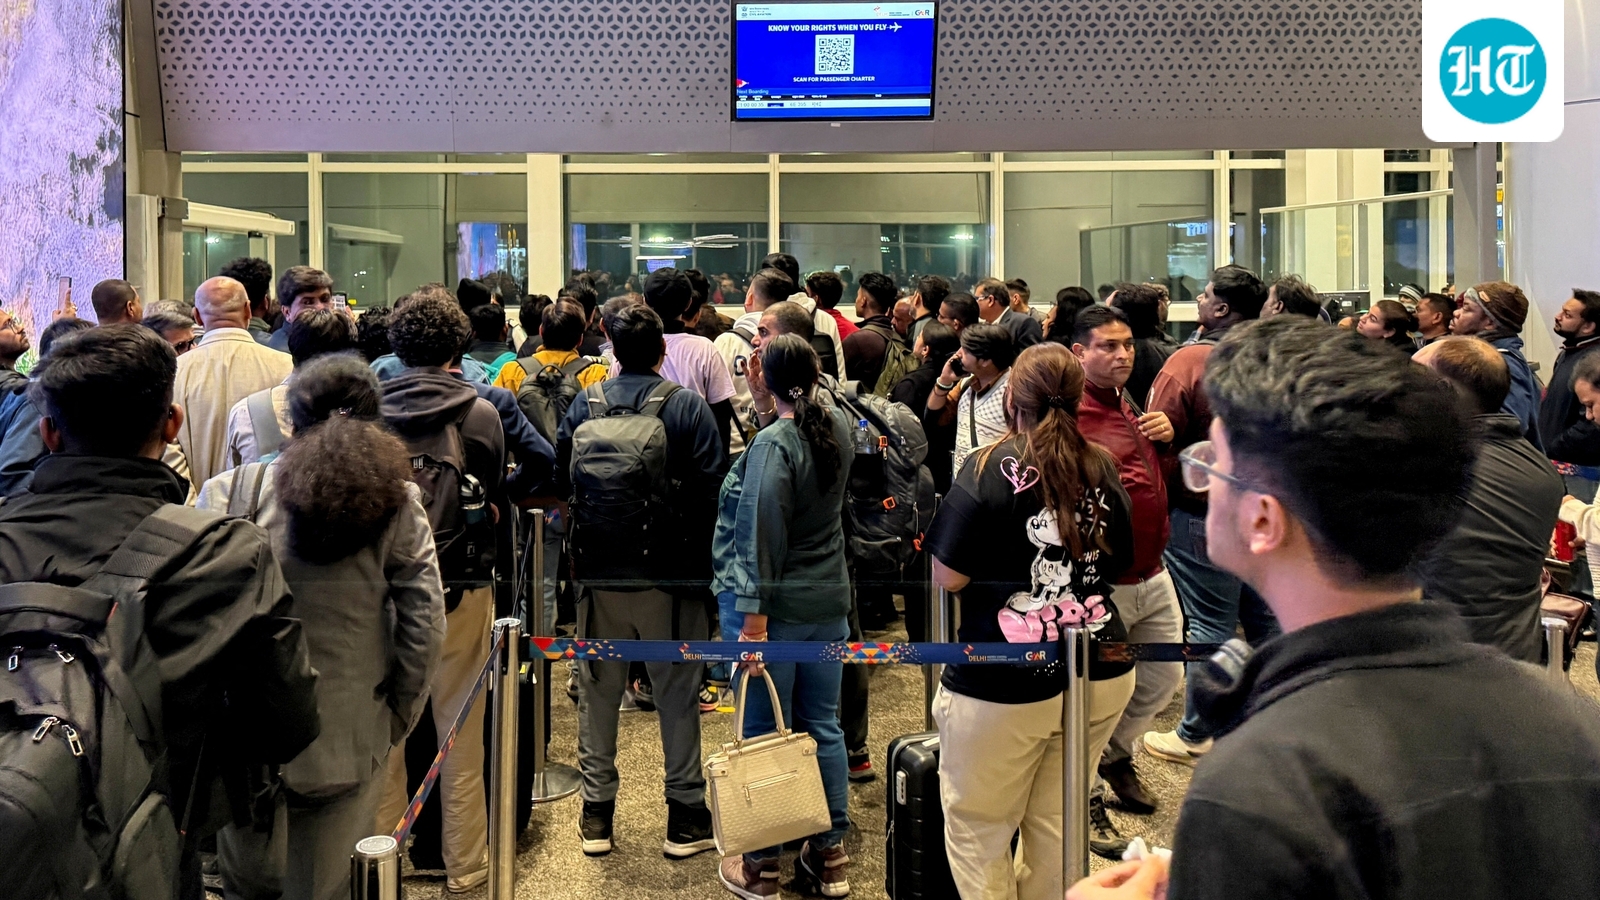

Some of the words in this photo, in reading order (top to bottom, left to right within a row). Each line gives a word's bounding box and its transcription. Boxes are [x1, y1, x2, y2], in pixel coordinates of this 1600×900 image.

[1079, 550, 1100, 563] HIS
[740, 651, 763, 661] GMR
[1025, 650, 1046, 661] GMR
